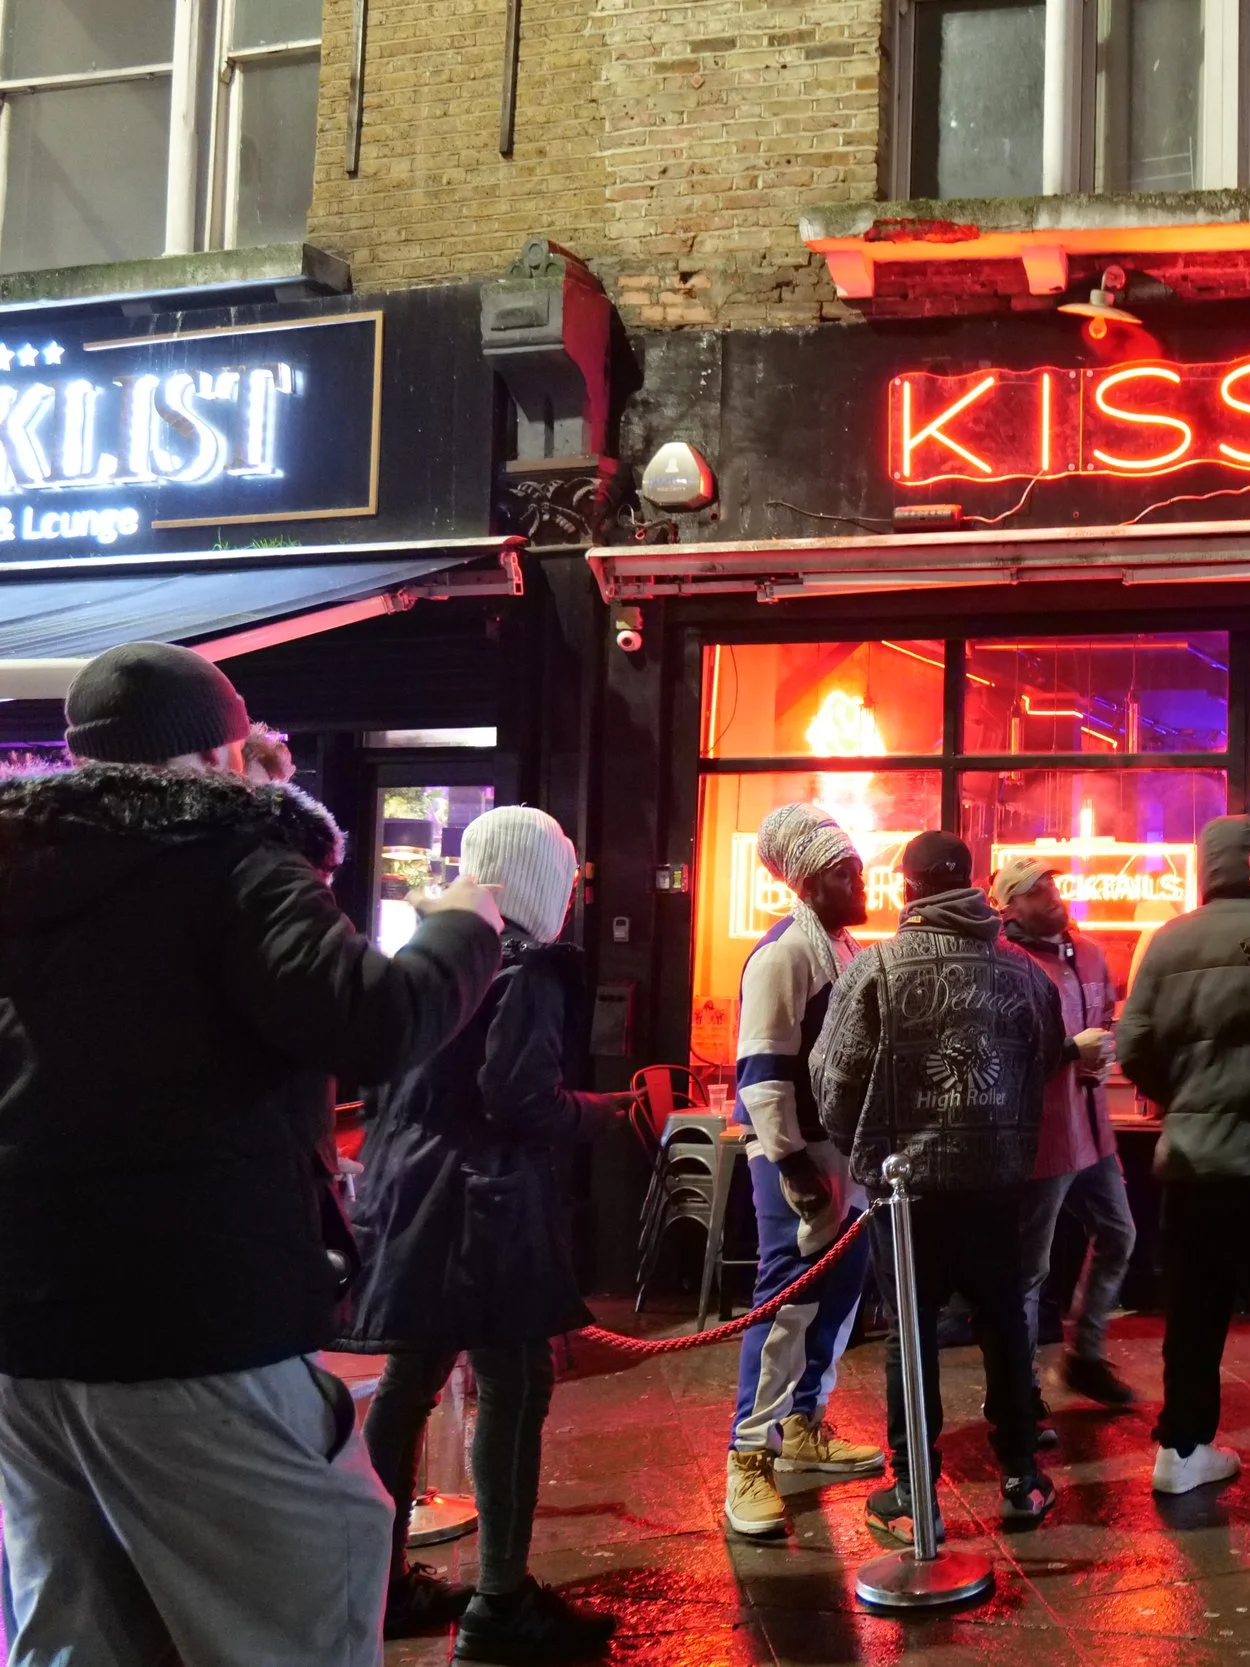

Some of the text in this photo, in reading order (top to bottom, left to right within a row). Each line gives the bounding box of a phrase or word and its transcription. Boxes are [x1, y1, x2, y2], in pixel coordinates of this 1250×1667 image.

[23, 505, 140, 544] Lounge
[1055, 873, 1186, 901] CKTAILS
[916, 1088, 1007, 1112] High Roller
